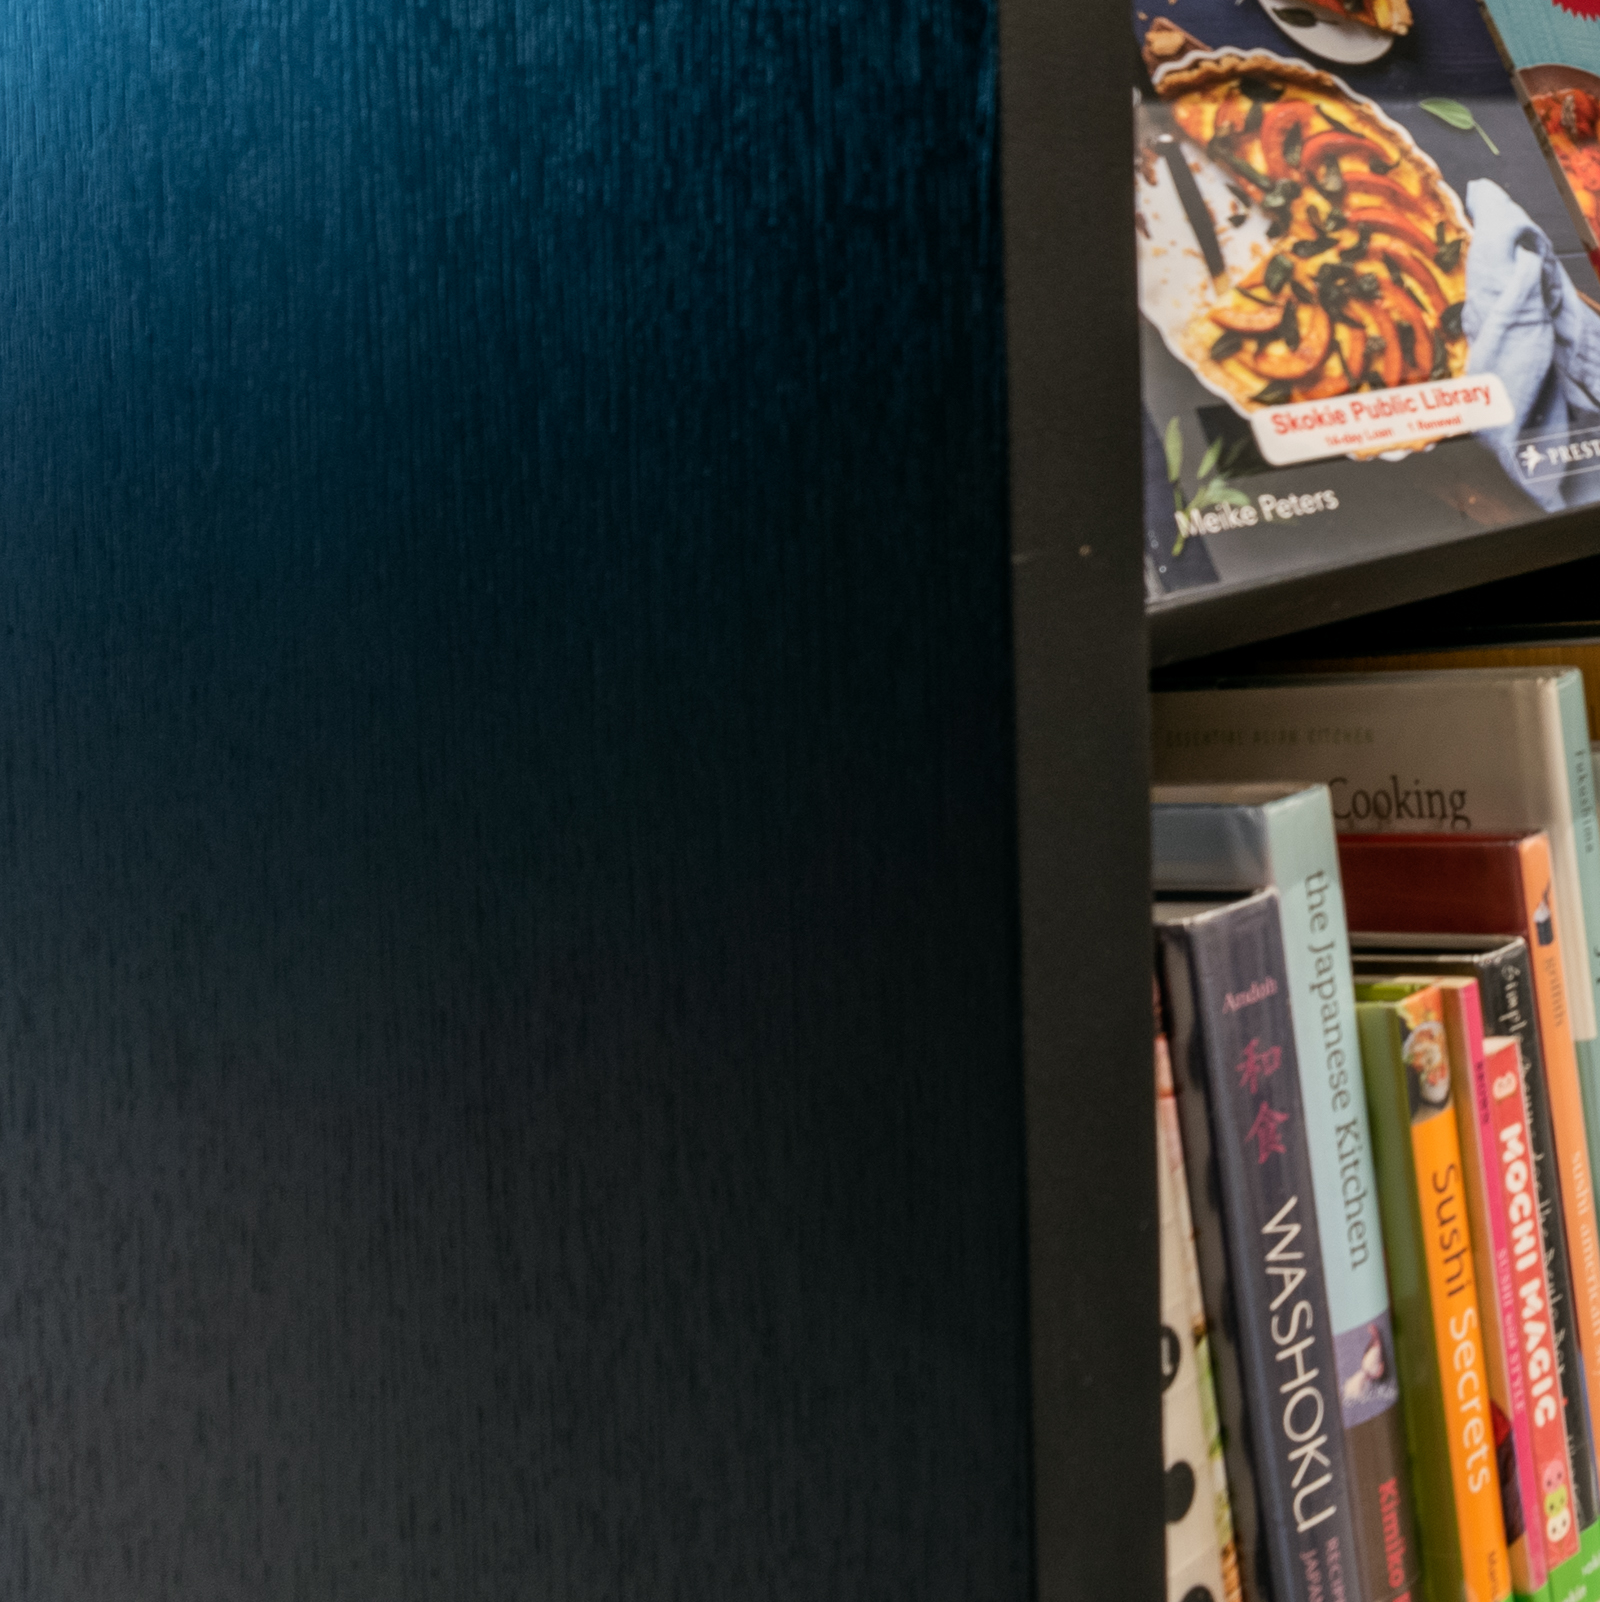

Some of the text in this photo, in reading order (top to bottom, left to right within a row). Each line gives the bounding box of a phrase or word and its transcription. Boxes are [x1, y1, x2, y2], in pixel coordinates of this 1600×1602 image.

[1176, 487, 1339, 540] Meike Peters
[1270, 378, 1492, 438] Skokie Public Library
[1327, 776, 1473, 830] Cooking
[1236, 1037, 1289, 1164] 和食
[1304, 869, 1373, 1273] the Japanese Kitchen
[1261, 1195, 1339, 1533] WASHOKU
[1431, 1163, 1491, 1495] Sushi Secrets
[1499, 1122, 1558, 1428] MOCHI MAGIC
